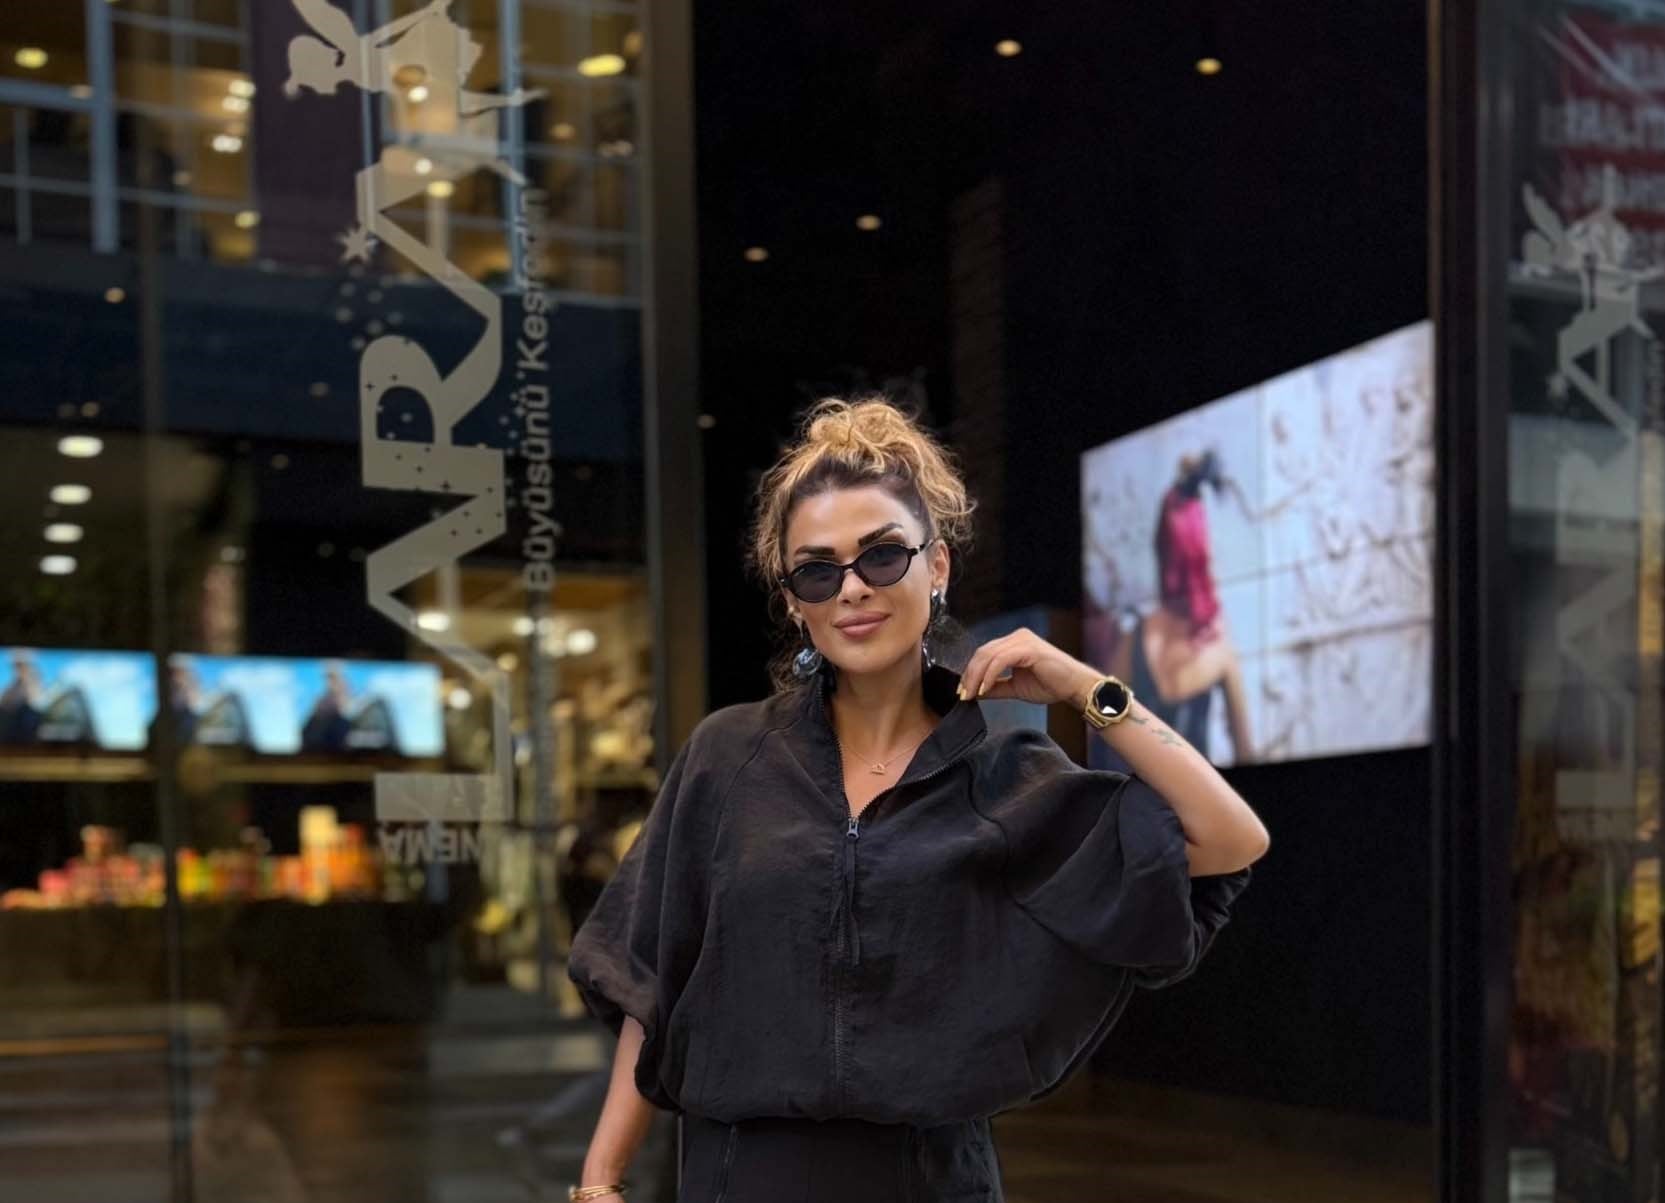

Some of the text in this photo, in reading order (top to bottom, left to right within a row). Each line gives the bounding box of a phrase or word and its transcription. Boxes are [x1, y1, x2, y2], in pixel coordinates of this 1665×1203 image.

[356, 110, 514, 821] LARA
[522, 384, 563, 591] Büyüsünü
[1556, 284, 1638, 806] LARA
